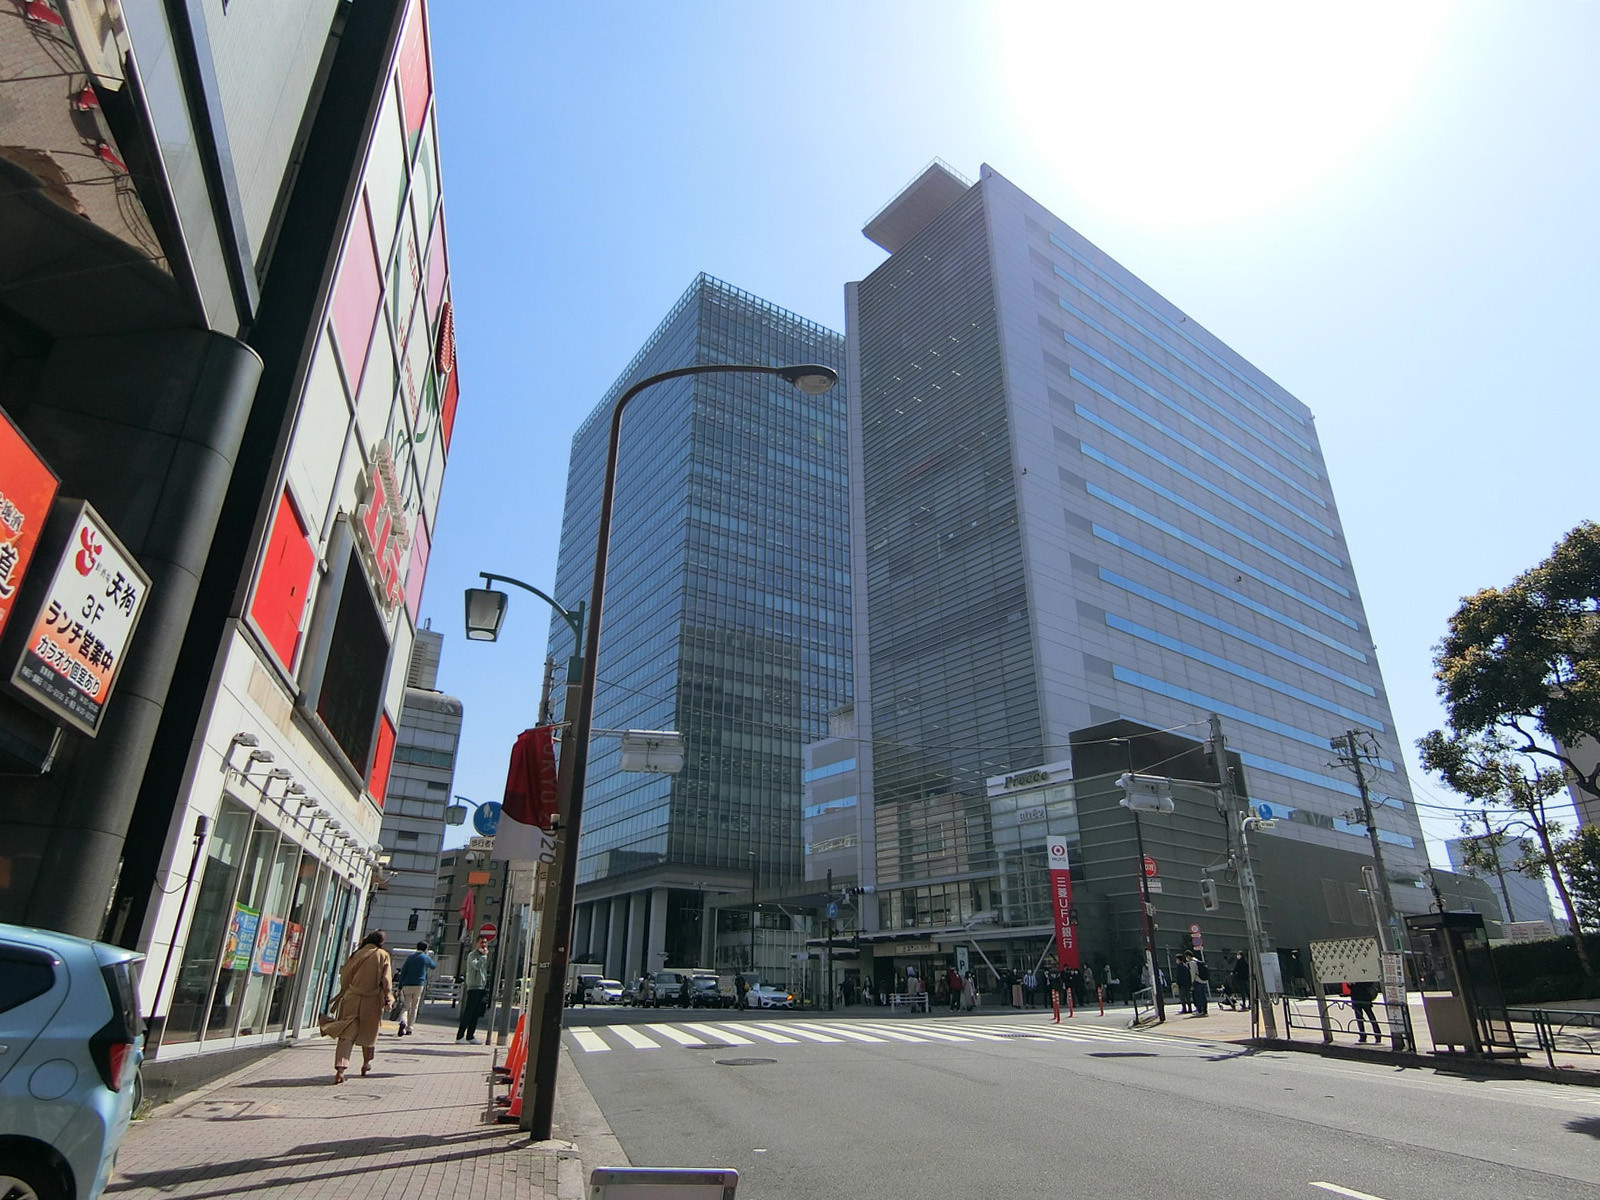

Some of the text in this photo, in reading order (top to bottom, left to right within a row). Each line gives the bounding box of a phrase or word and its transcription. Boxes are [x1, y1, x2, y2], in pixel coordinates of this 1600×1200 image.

[0, 493, 24, 532] 地酒
[82, 593, 105, 624] 3F
[105, 571, 136, 617] 天狗
[46, 600, 114, 674] ランチ営業中
[37, 636, 100, 695] カラオケ個室あり
[1003, 770, 1049, 789] Precce
[472, 839, 495, 849] 歩行者
[1056, 876, 1073, 949] 三菱UFJ銀行
[960, 960, 966, 971] P
